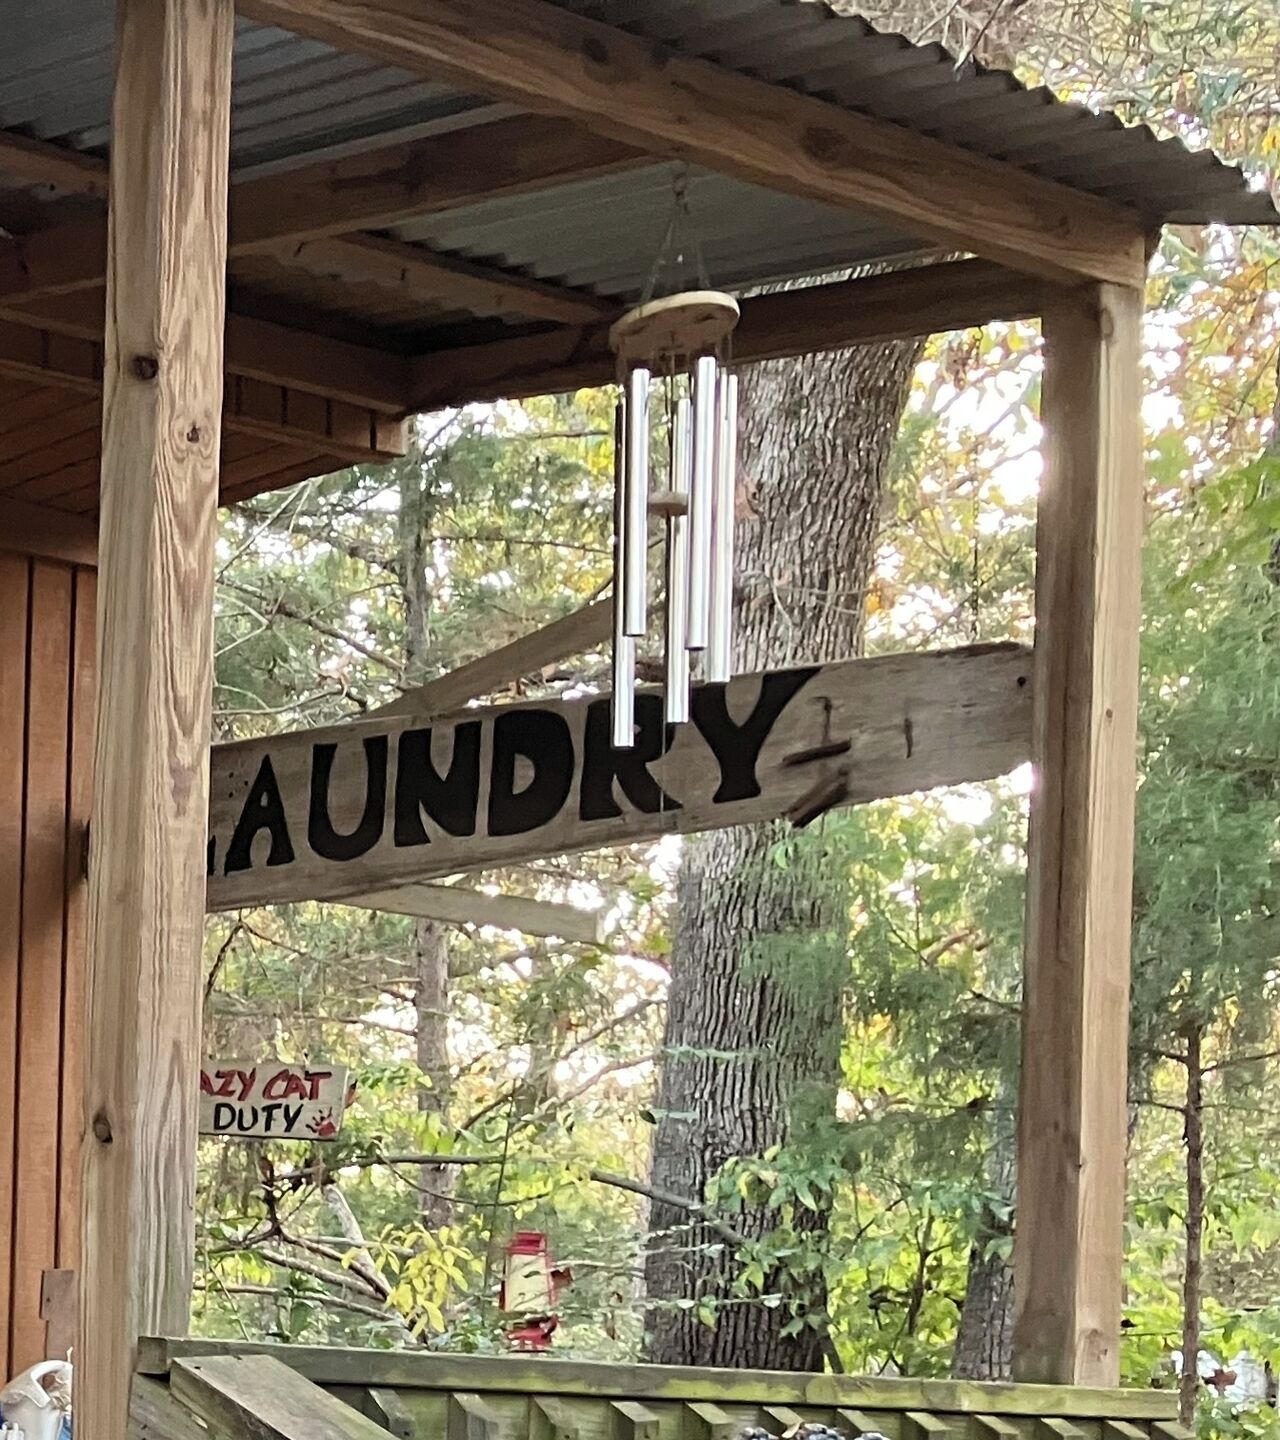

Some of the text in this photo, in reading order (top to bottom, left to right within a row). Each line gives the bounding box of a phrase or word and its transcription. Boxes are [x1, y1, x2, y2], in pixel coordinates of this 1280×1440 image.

[207, 664, 822, 877] AUNDRY
[262, 1068, 332, 1101] CAT
[213, 1103, 304, 1133] DUTY
